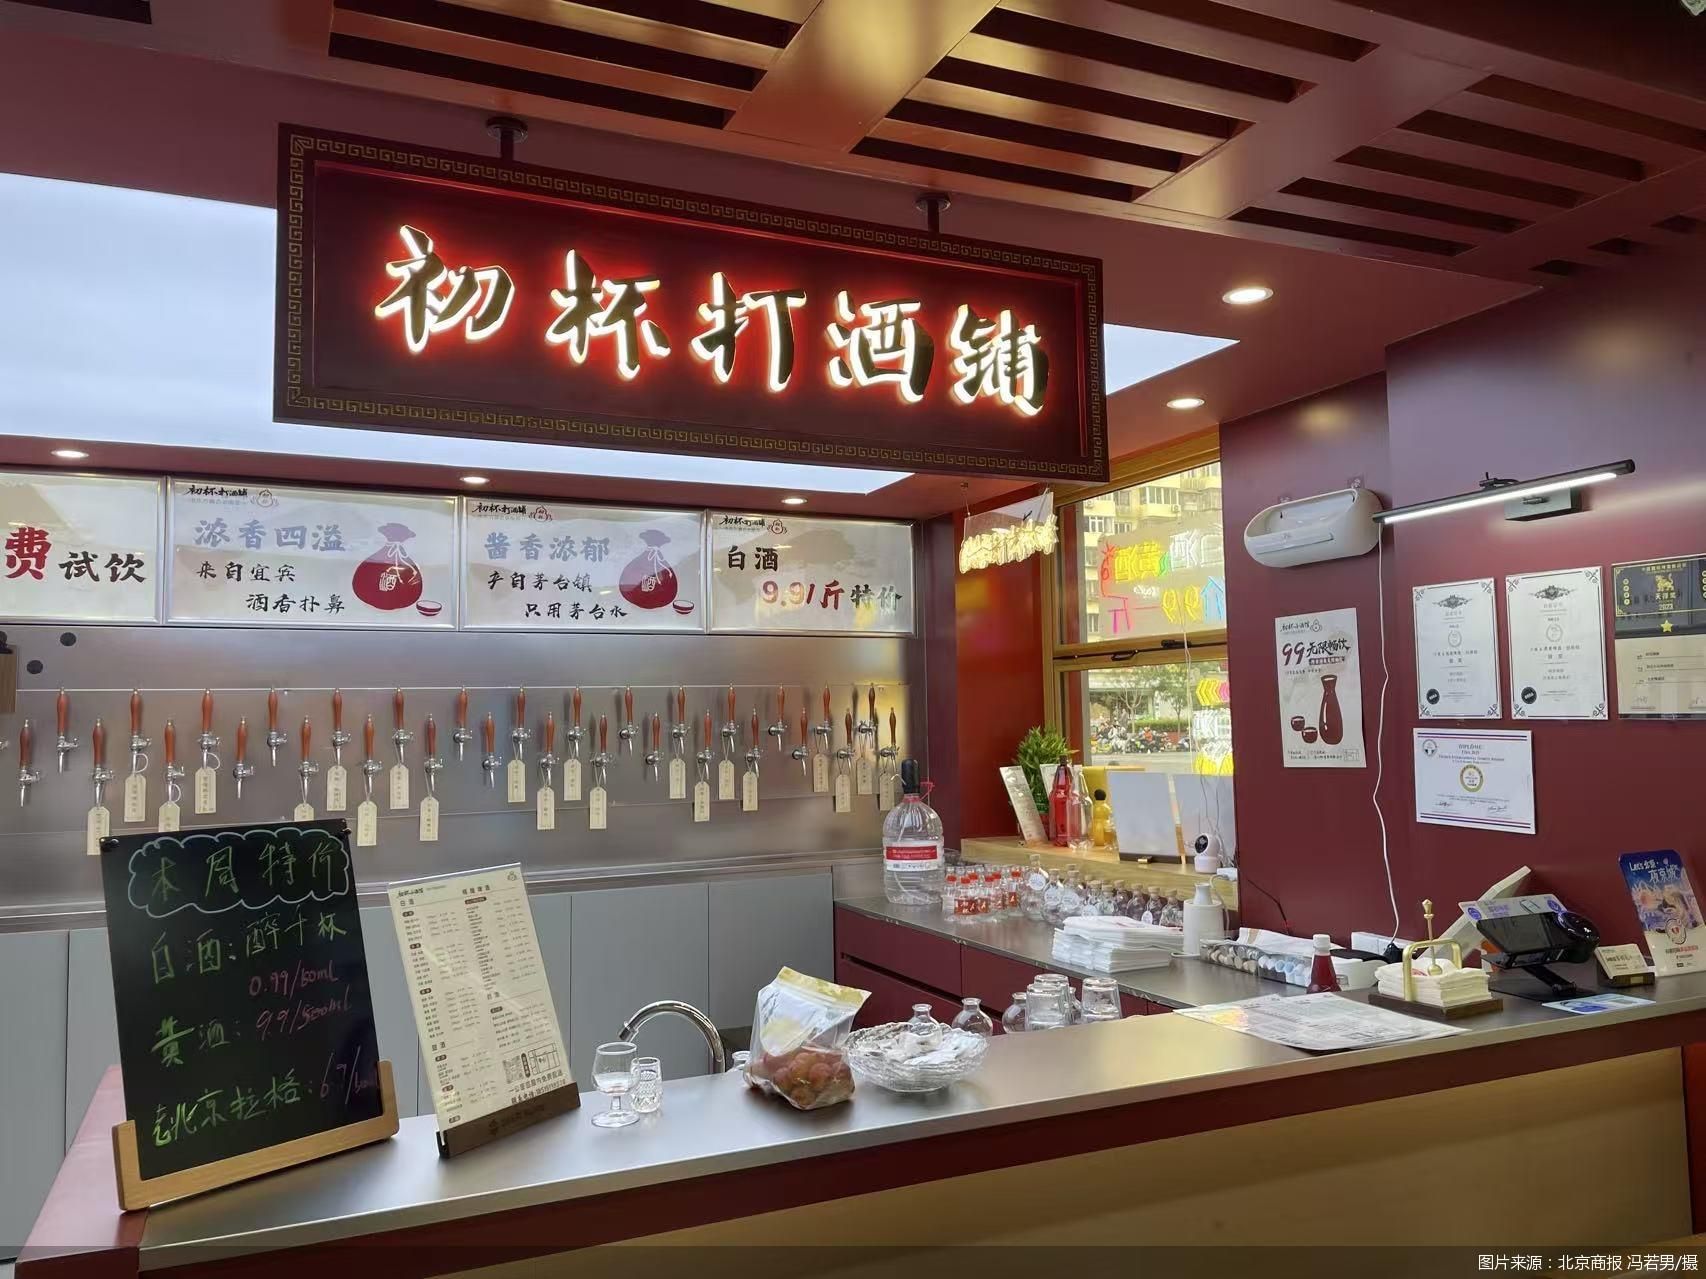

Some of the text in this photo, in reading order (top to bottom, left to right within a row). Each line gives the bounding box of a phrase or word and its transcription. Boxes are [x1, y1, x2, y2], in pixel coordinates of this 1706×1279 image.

[374, 224, 1050, 418] 初杯打酒铺
[194, 518, 345, 552] 浓香四溢
[484, 533, 610, 562] 酱香浓郁
[727, 545, 779, 571] 白酒
[197, 563, 297, 583] 来自宜宾
[487, 571, 593, 593] 产自茅台镇
[245, 594, 346, 613] 酒香扑鼻
[525, 602, 628, 619] 只用茅台水
[151, 840, 334, 901] 本周特价
